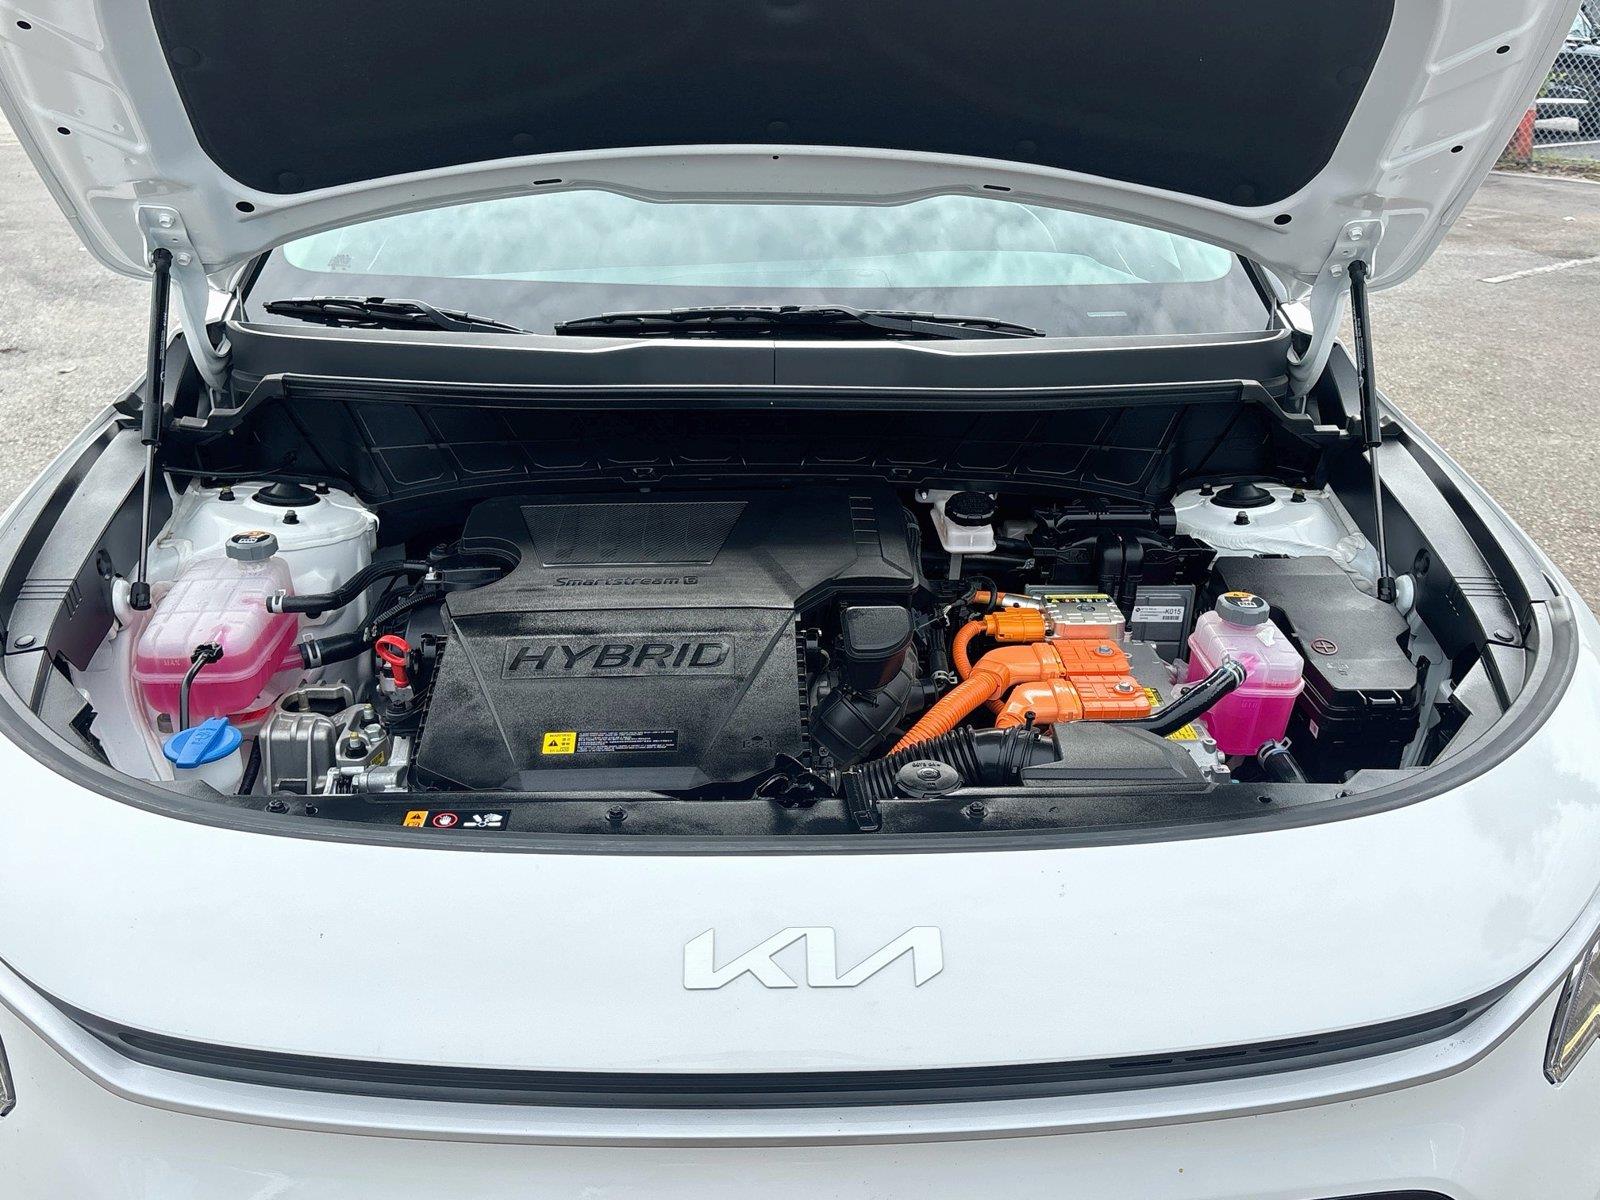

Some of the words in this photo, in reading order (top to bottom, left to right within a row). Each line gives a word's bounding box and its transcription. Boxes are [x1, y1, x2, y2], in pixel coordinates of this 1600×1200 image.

[553, 576, 680, 587] Smartstream
[508, 642, 731, 671] HYBRID
[683, 925, 944, 990] KIA
